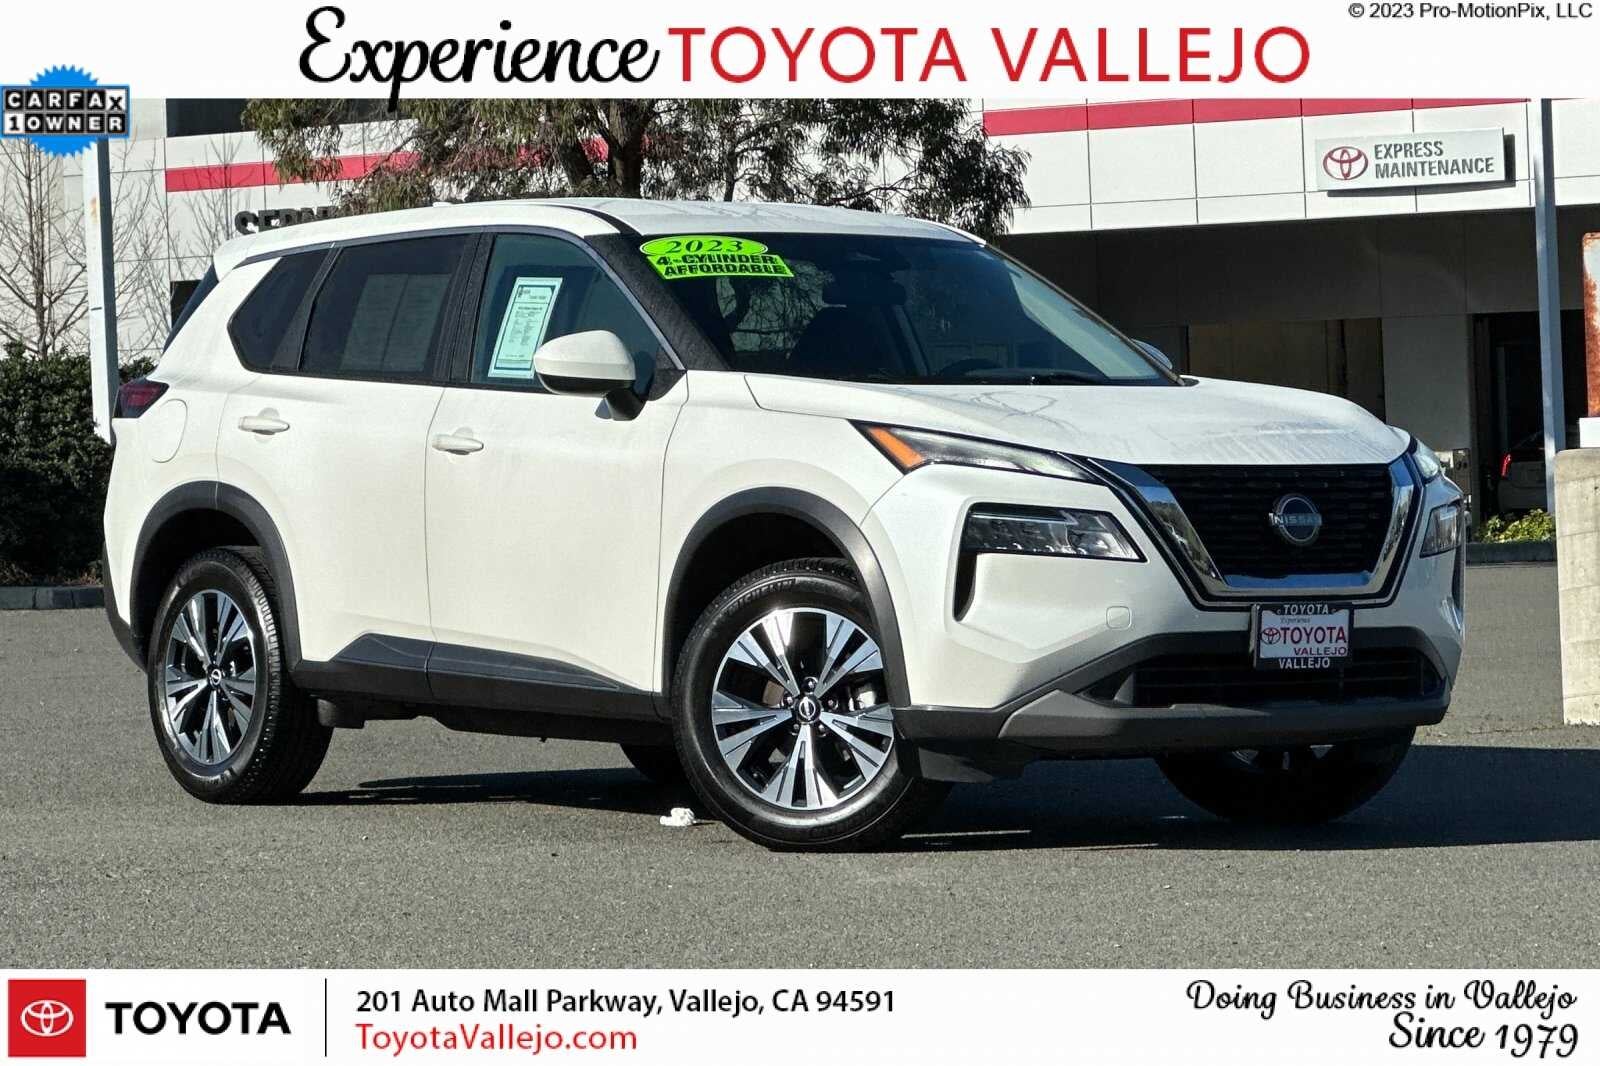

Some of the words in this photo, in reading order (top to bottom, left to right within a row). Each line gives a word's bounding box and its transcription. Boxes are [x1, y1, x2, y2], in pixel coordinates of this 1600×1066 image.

[1374, 141, 1444, 161] EXPRESS
[1375, 157, 1495, 179] MAINTENANCE
[665, 239, 744, 254] 2023
[664, 264, 784, 276] AFFORDABLE
[1283, 603, 1330, 616] TOYOTA
[1280, 626, 1347, 645] TOYOTA
[1293, 646, 1348, 657] VALLEJO
[1278, 657, 1331, 669] VALLEJO
